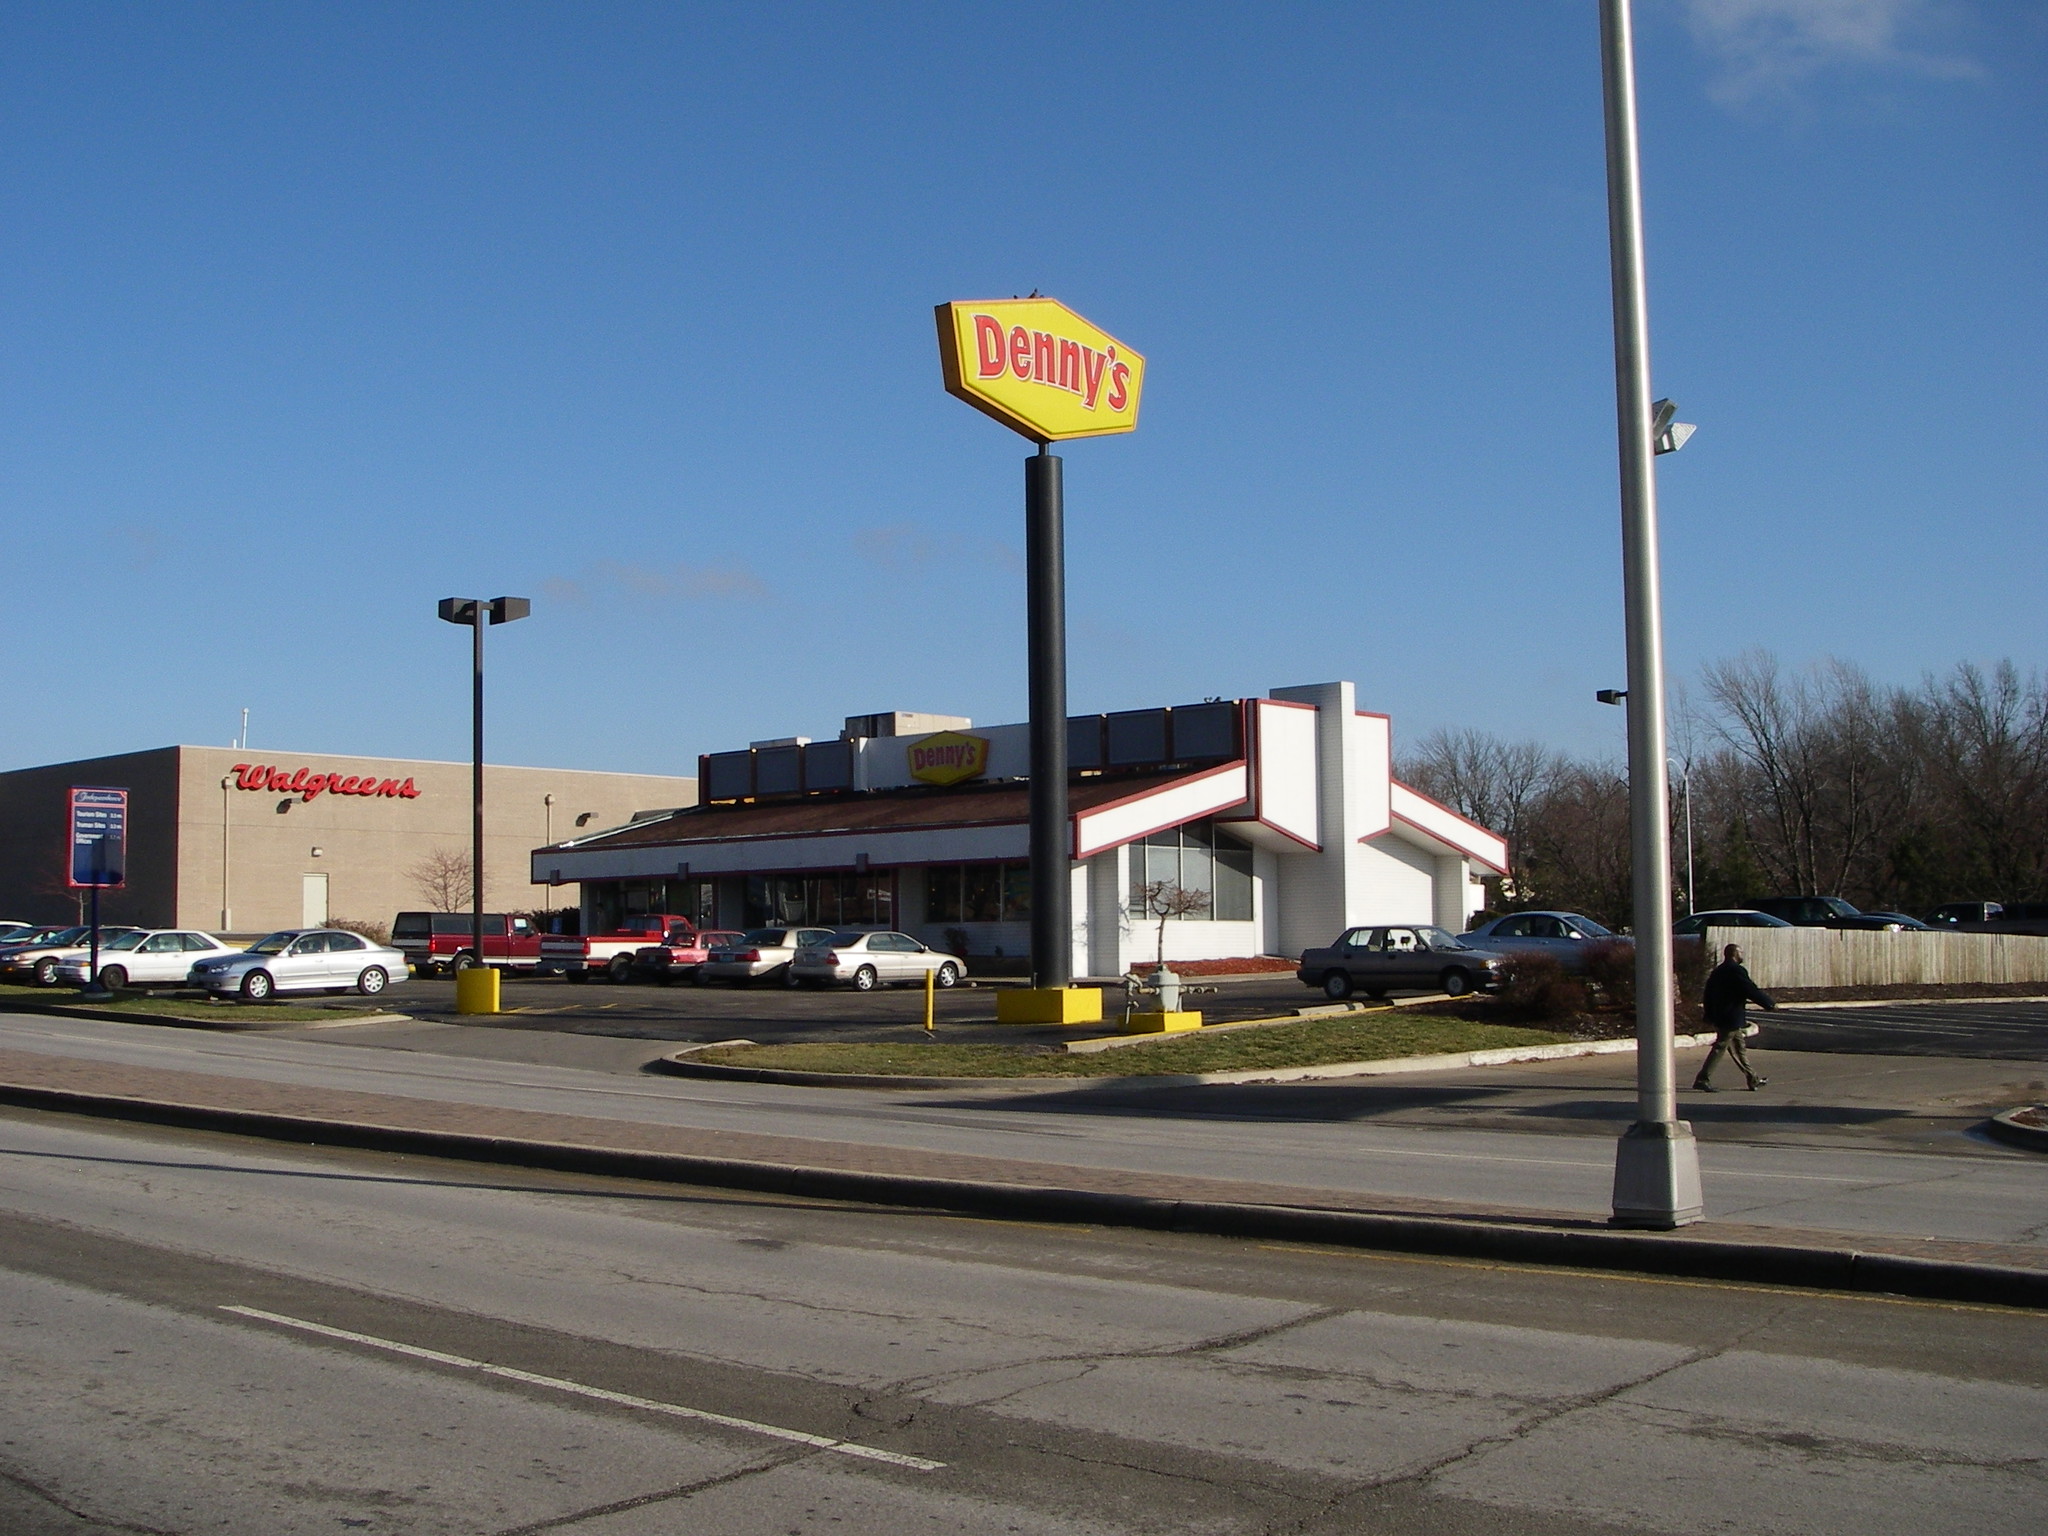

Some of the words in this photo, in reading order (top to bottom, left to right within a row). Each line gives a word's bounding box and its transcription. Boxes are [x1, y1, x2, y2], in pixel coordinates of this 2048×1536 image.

[972, 314, 1130, 412] Denny's
[913, 741, 976, 770] Denny's
[77, 792, 122, 802] Independence
[231, 763, 421, 802] Walgreens
